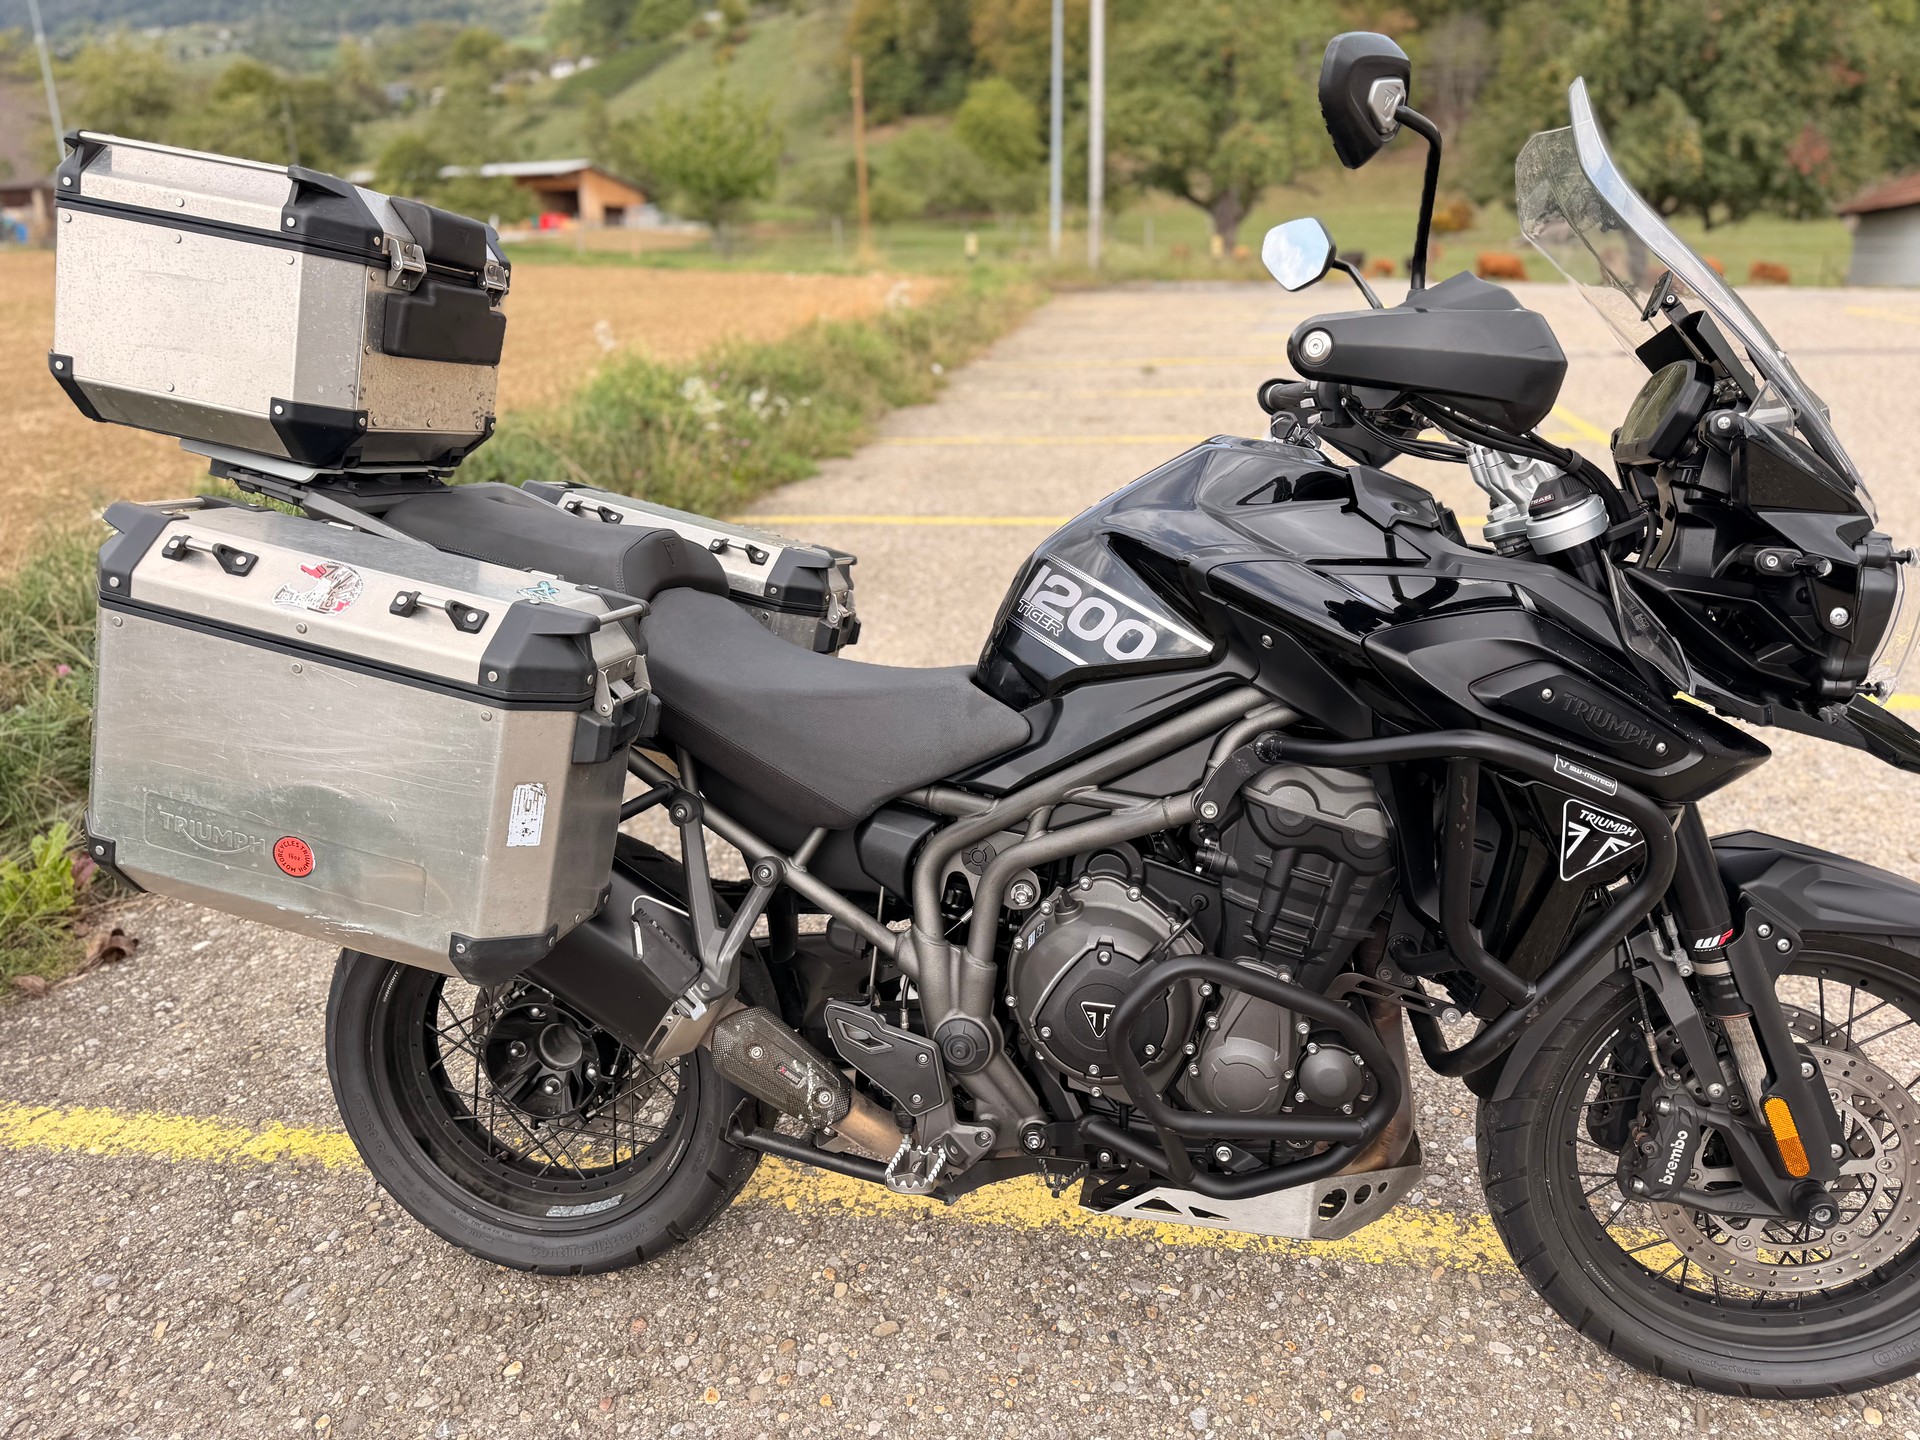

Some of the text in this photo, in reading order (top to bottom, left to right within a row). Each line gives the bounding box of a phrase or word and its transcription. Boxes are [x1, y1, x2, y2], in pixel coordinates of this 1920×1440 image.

[1017, 598, 1064, 637] TIGER
[1021, 565, 1157, 660] 1200
[1563, 691, 1655, 750] TRIUMPH
[159, 810, 266, 856] TRIUMPH
[1579, 809, 1637, 837] TRIUMPH
[277, 840, 311, 873] MOTORCYCLES TRIUMPH
[1658, 1130, 1688, 1185] brembo
[530, 1222, 648, 1258] ContiTrailAttack
